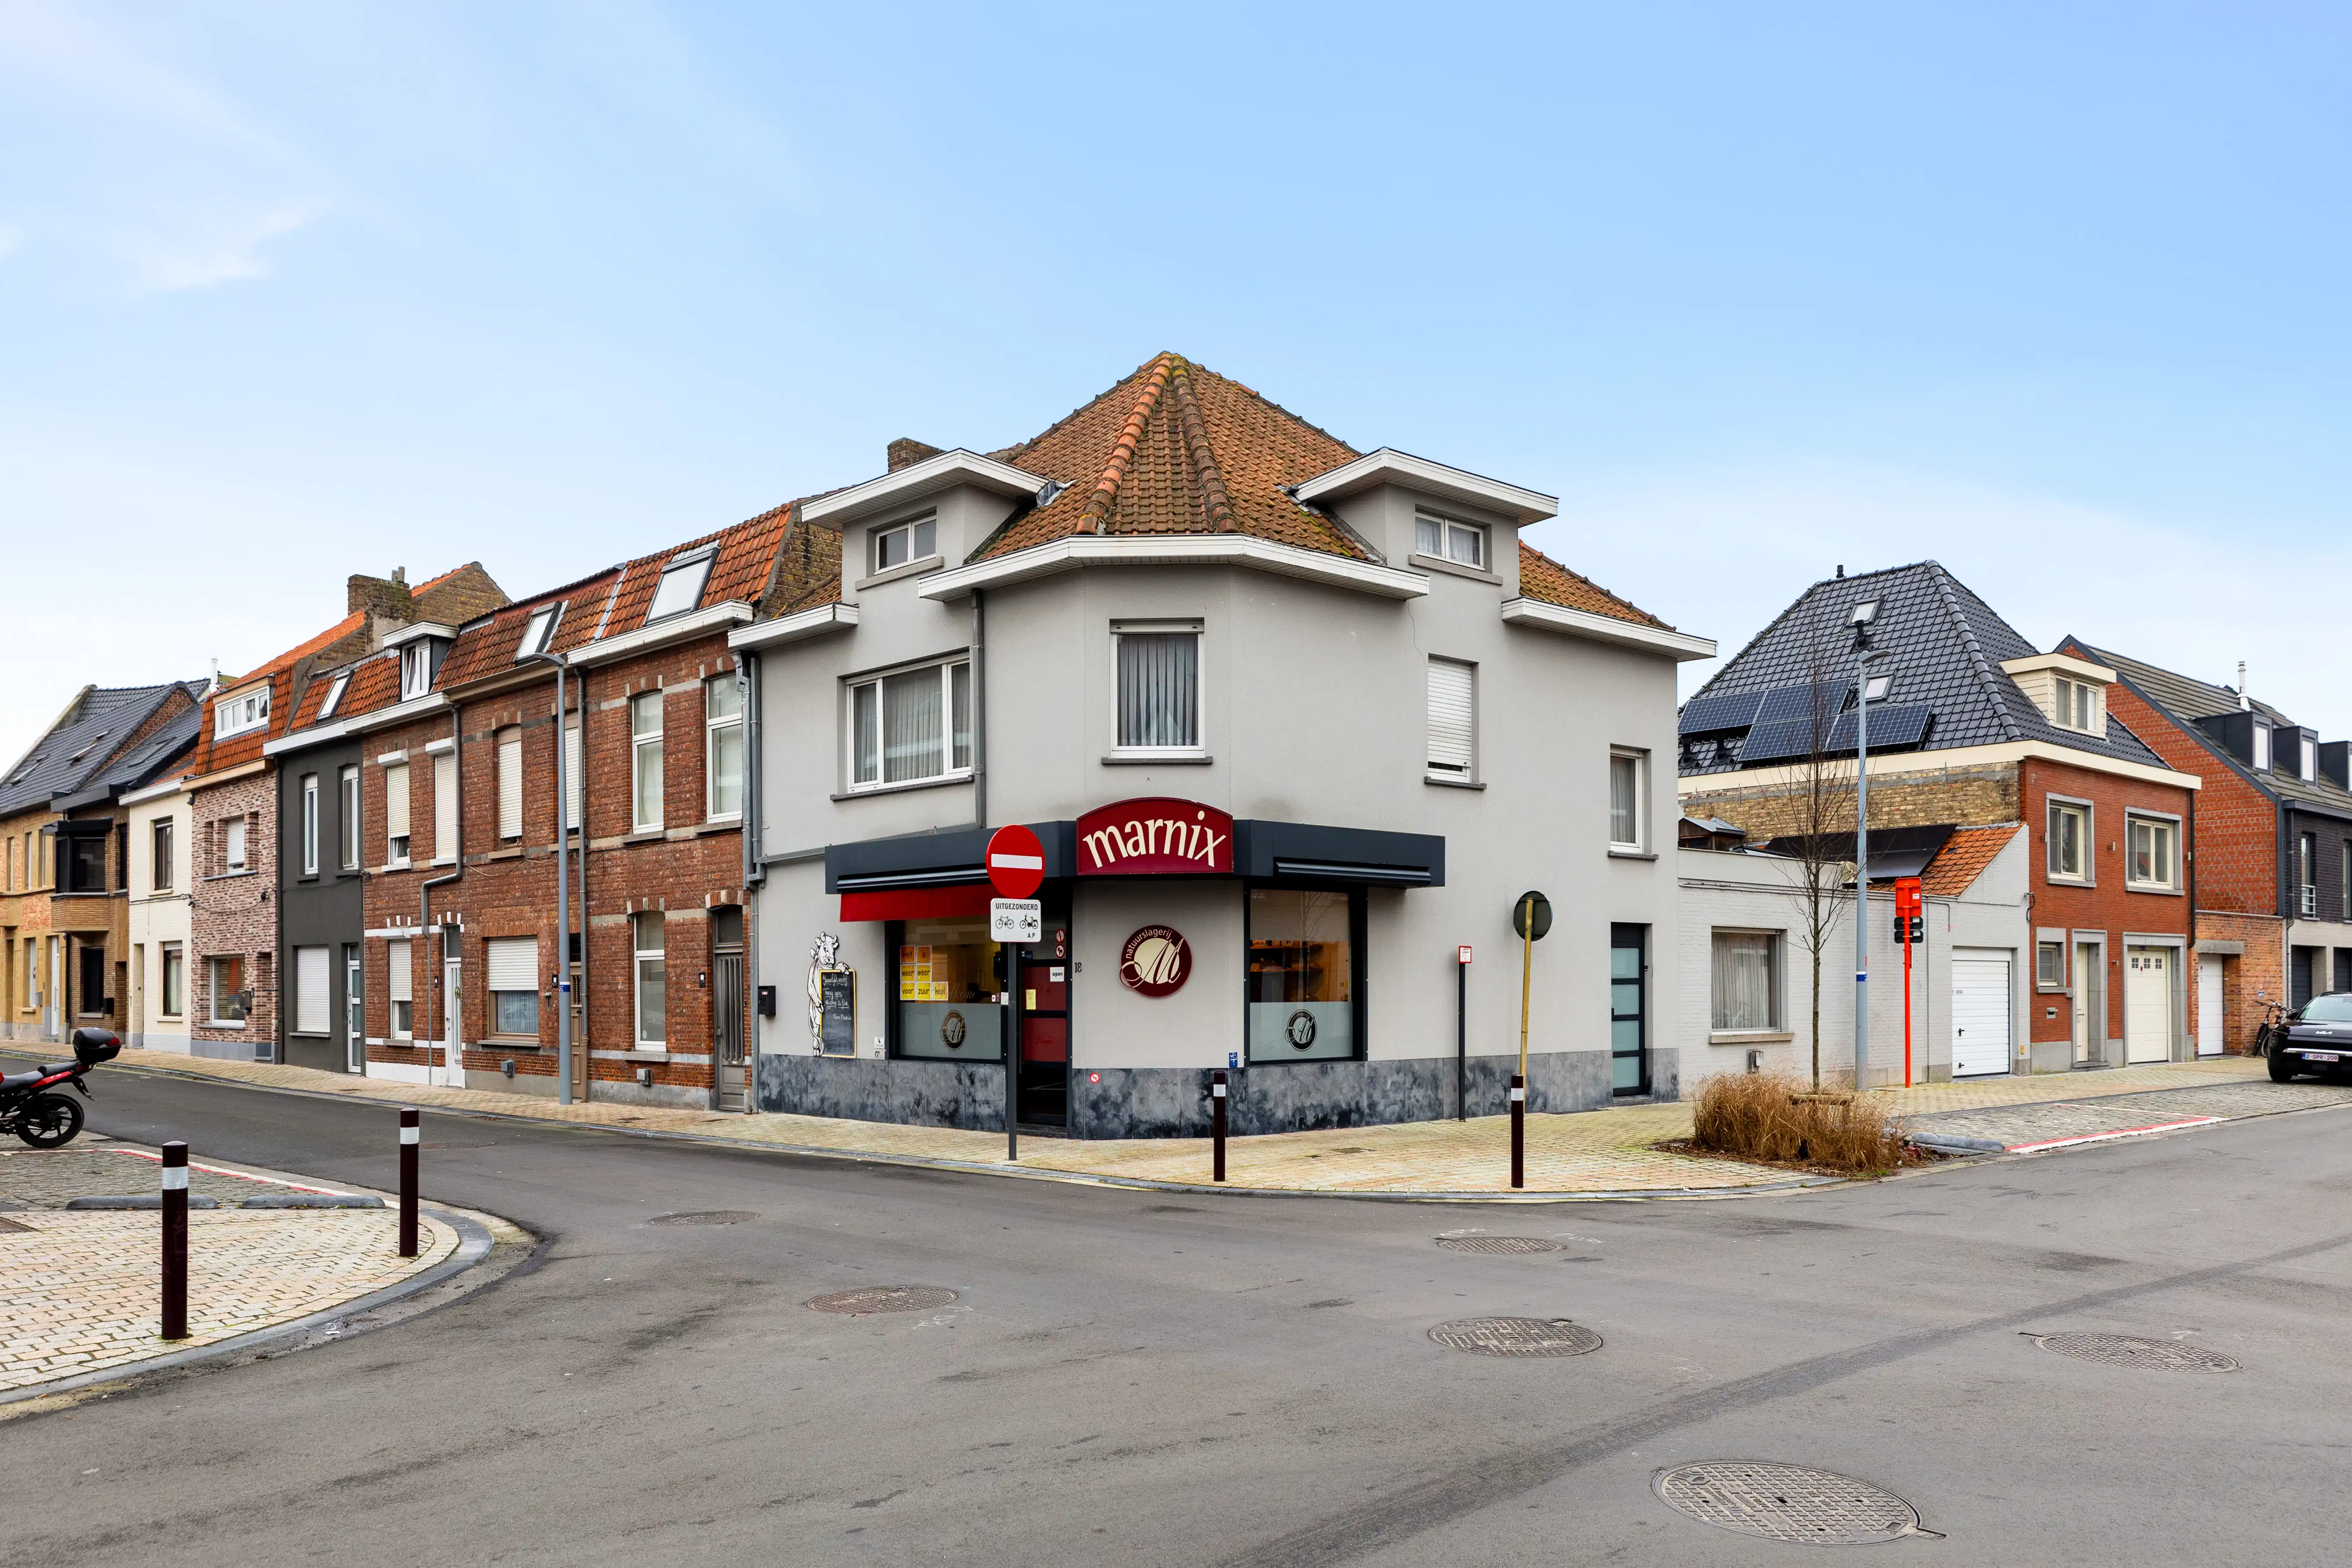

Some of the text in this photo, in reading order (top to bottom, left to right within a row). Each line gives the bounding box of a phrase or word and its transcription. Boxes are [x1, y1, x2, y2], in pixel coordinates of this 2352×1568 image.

[1082, 810, 1227, 869] marnix
[1125, 929, 1173, 959] natuurslagerij
[1074, 962, 1082, 973] 18
[934, 987, 946, 995] kool
